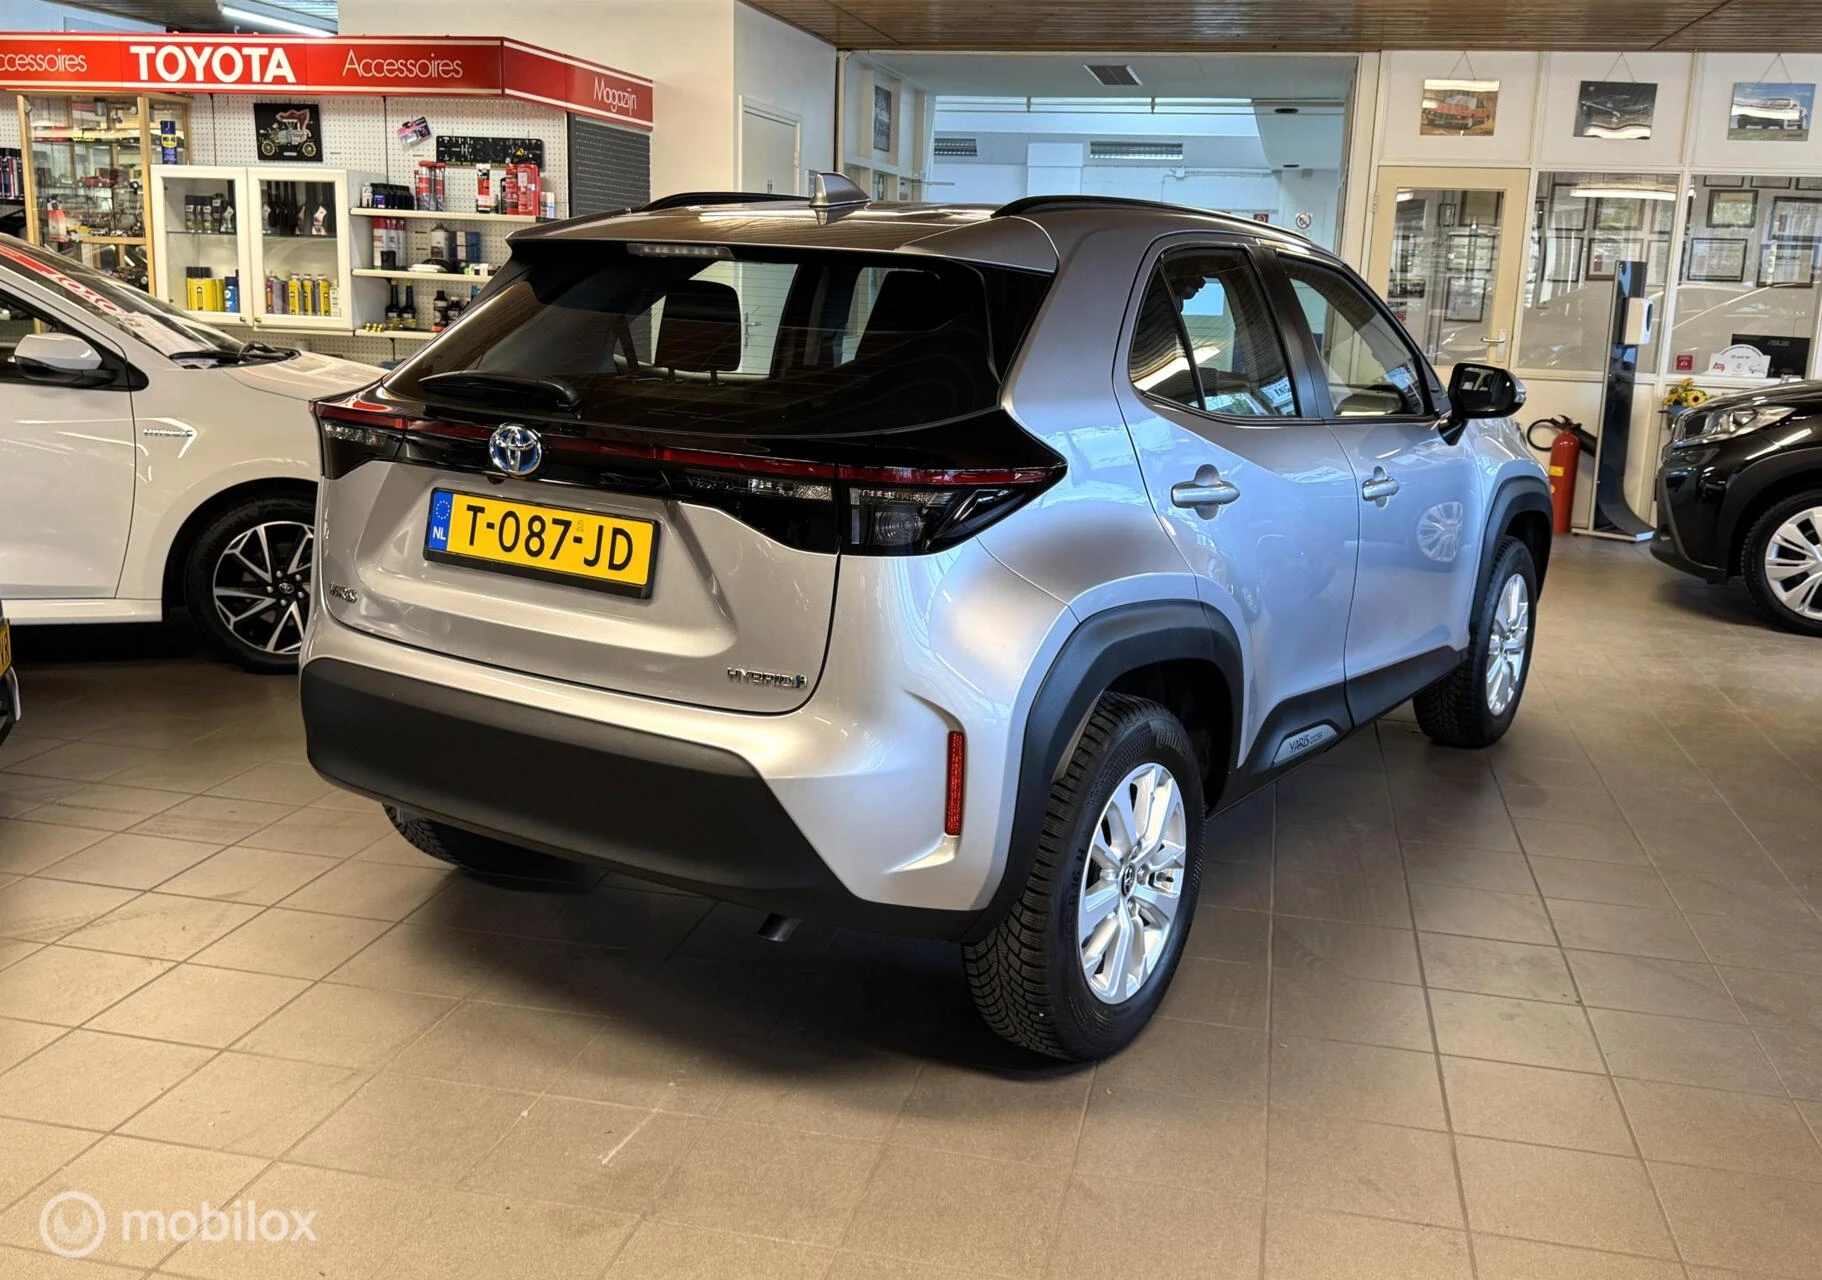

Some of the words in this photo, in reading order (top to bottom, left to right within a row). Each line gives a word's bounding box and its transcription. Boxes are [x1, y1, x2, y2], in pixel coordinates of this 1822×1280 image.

[129, 45, 297, 84] TOYOTA
[342, 49, 463, 79] Accessoires
[593, 75, 637, 116] Magazijn
[432, 525, 446, 541] NL
[466, 504, 633, 571] T-087-JD
[727, 667, 794, 688] HYBRID
[1289, 733, 1310, 753] YARIS
